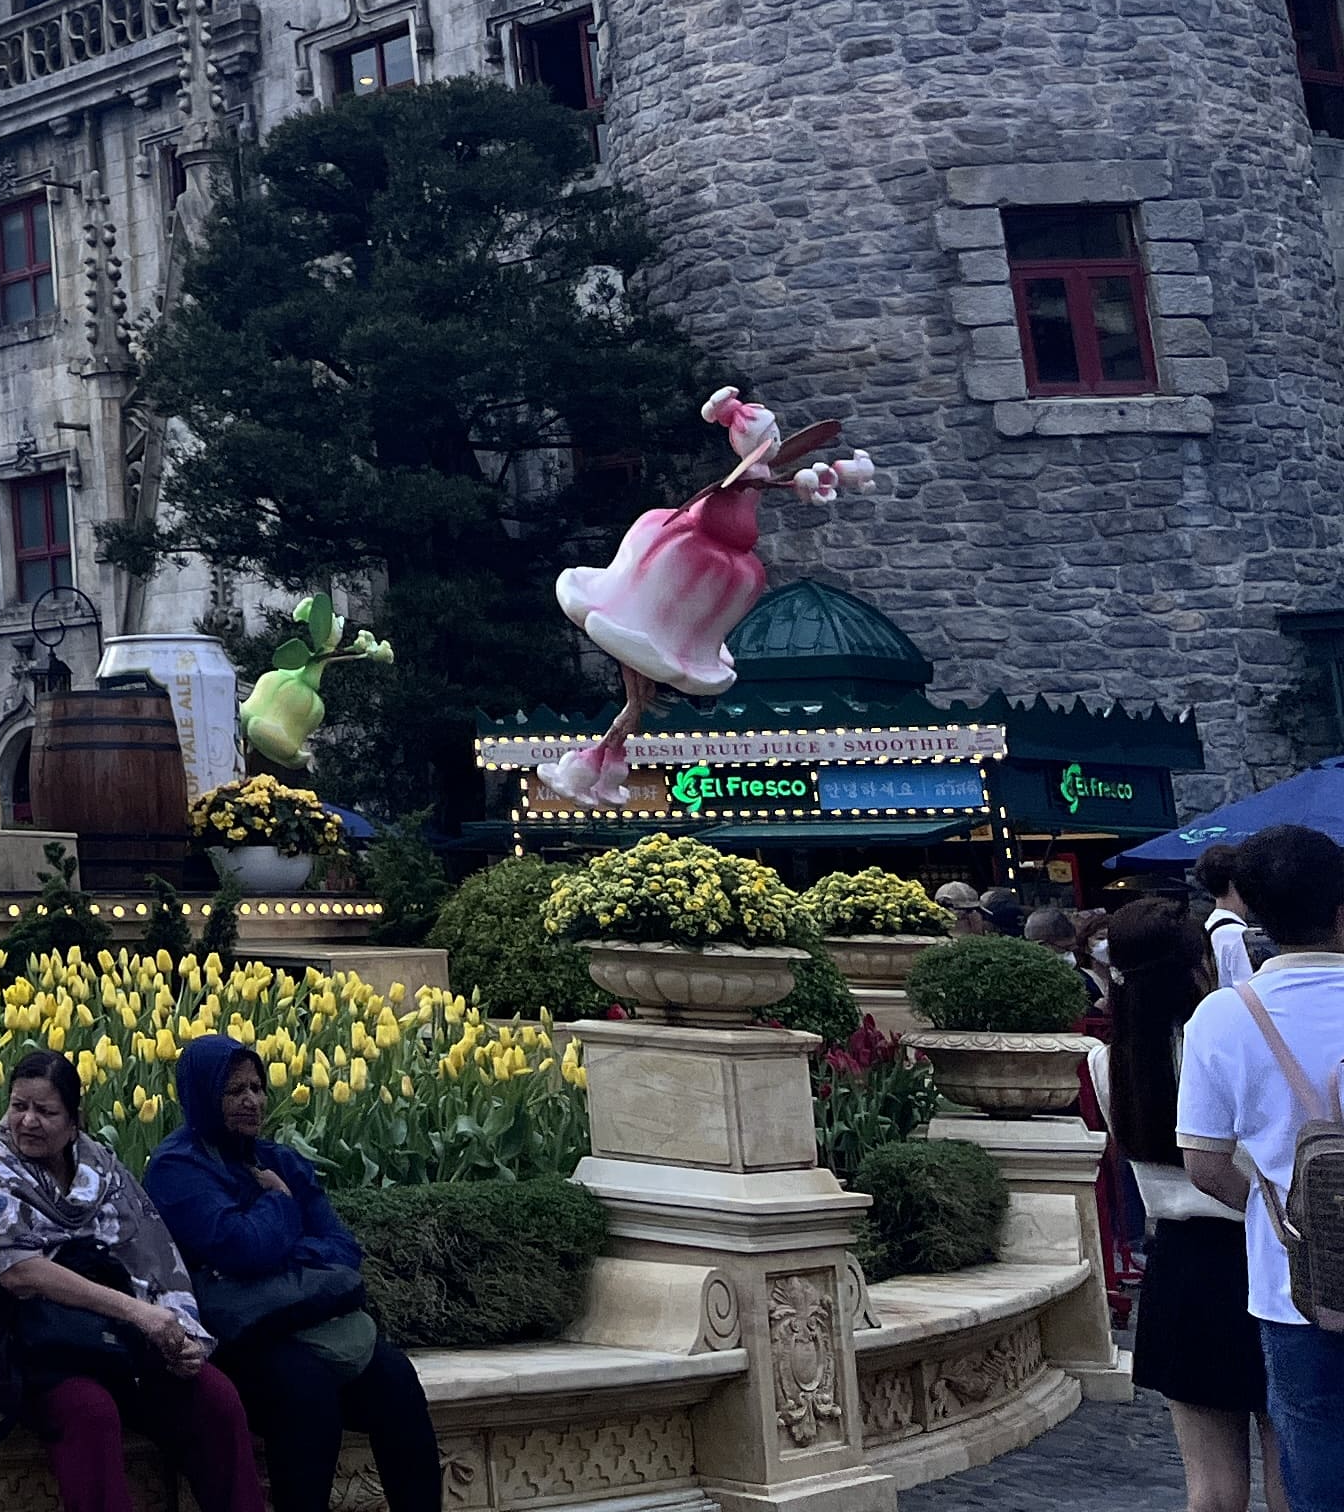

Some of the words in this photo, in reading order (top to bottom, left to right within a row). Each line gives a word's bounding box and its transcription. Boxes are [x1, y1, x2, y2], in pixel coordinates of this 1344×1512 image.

[175, 674, 193, 711] ALE
[179, 717, 197, 764] PALE
[692, 743, 751, 756] FRUIT
[759, 741, 820, 755] JUICE
[844, 737, 959, 753] SMOOTHIE
[700, 778, 724, 798] El
[726, 776, 806, 797] Fresco
[1075, 777, 1090, 797] El
